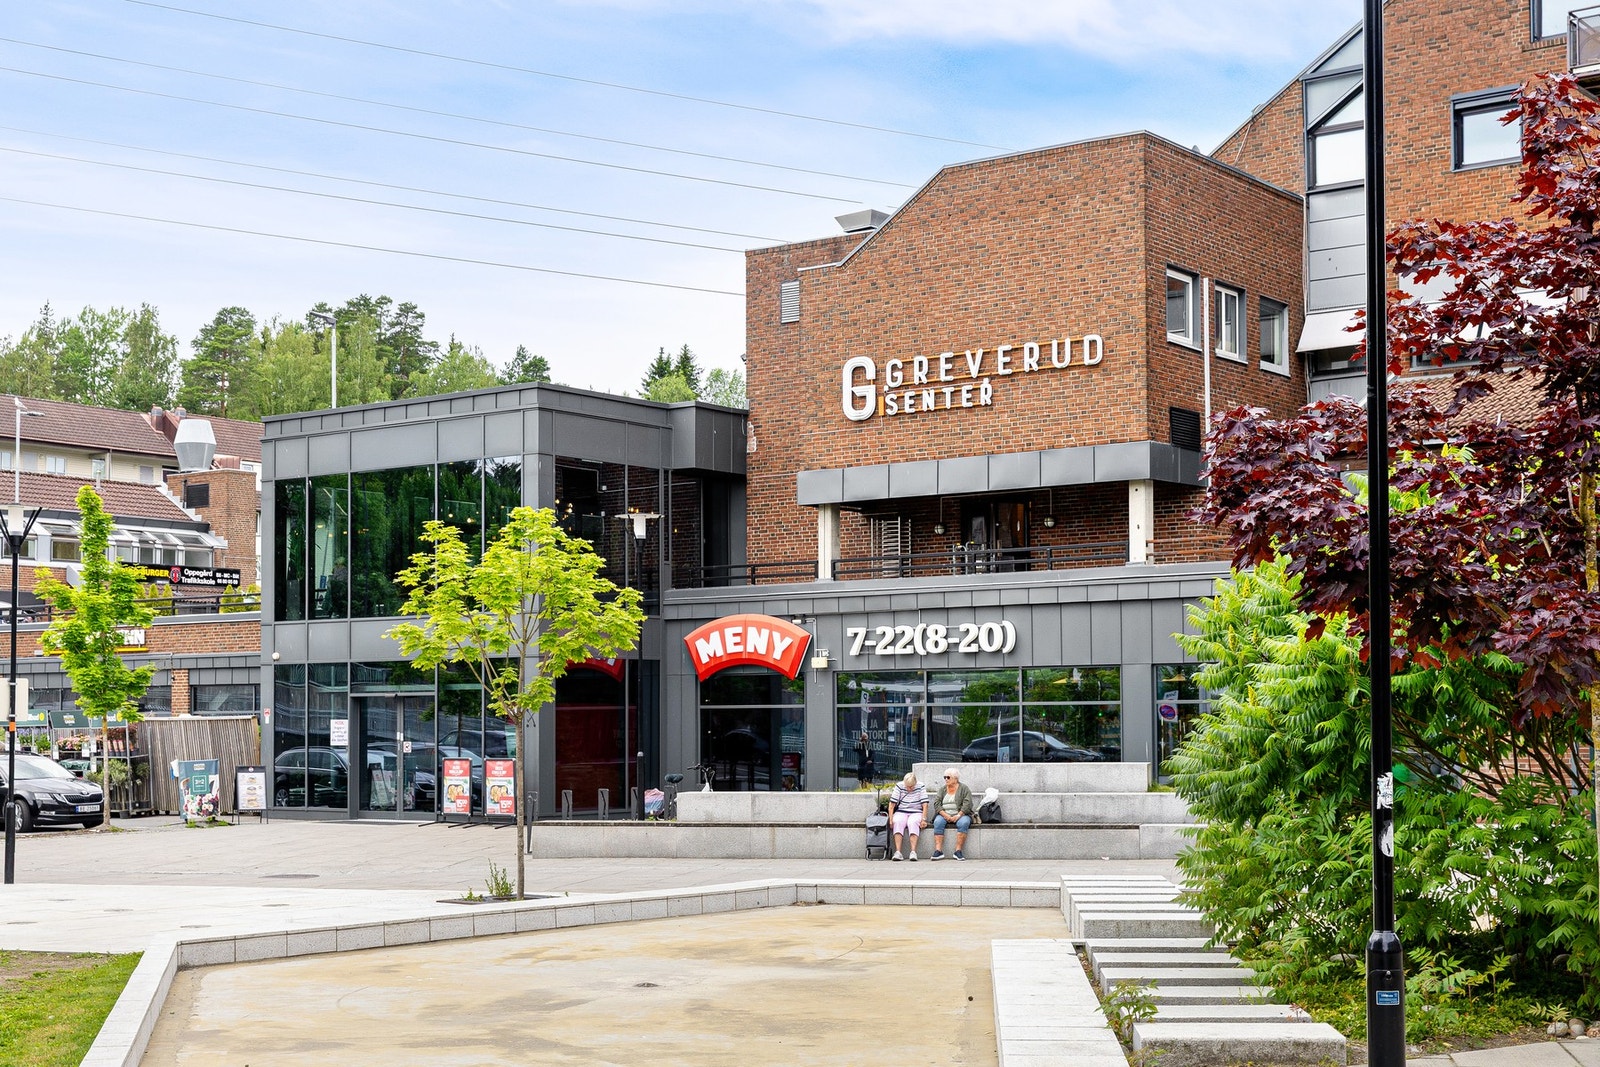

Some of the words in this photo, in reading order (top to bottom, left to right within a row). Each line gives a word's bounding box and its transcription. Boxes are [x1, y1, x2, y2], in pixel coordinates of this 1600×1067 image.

[885, 334, 1103, 388] GREVERUD
[885, 382, 993, 416] SENTER
[694, 626, 794, 664] MENY
